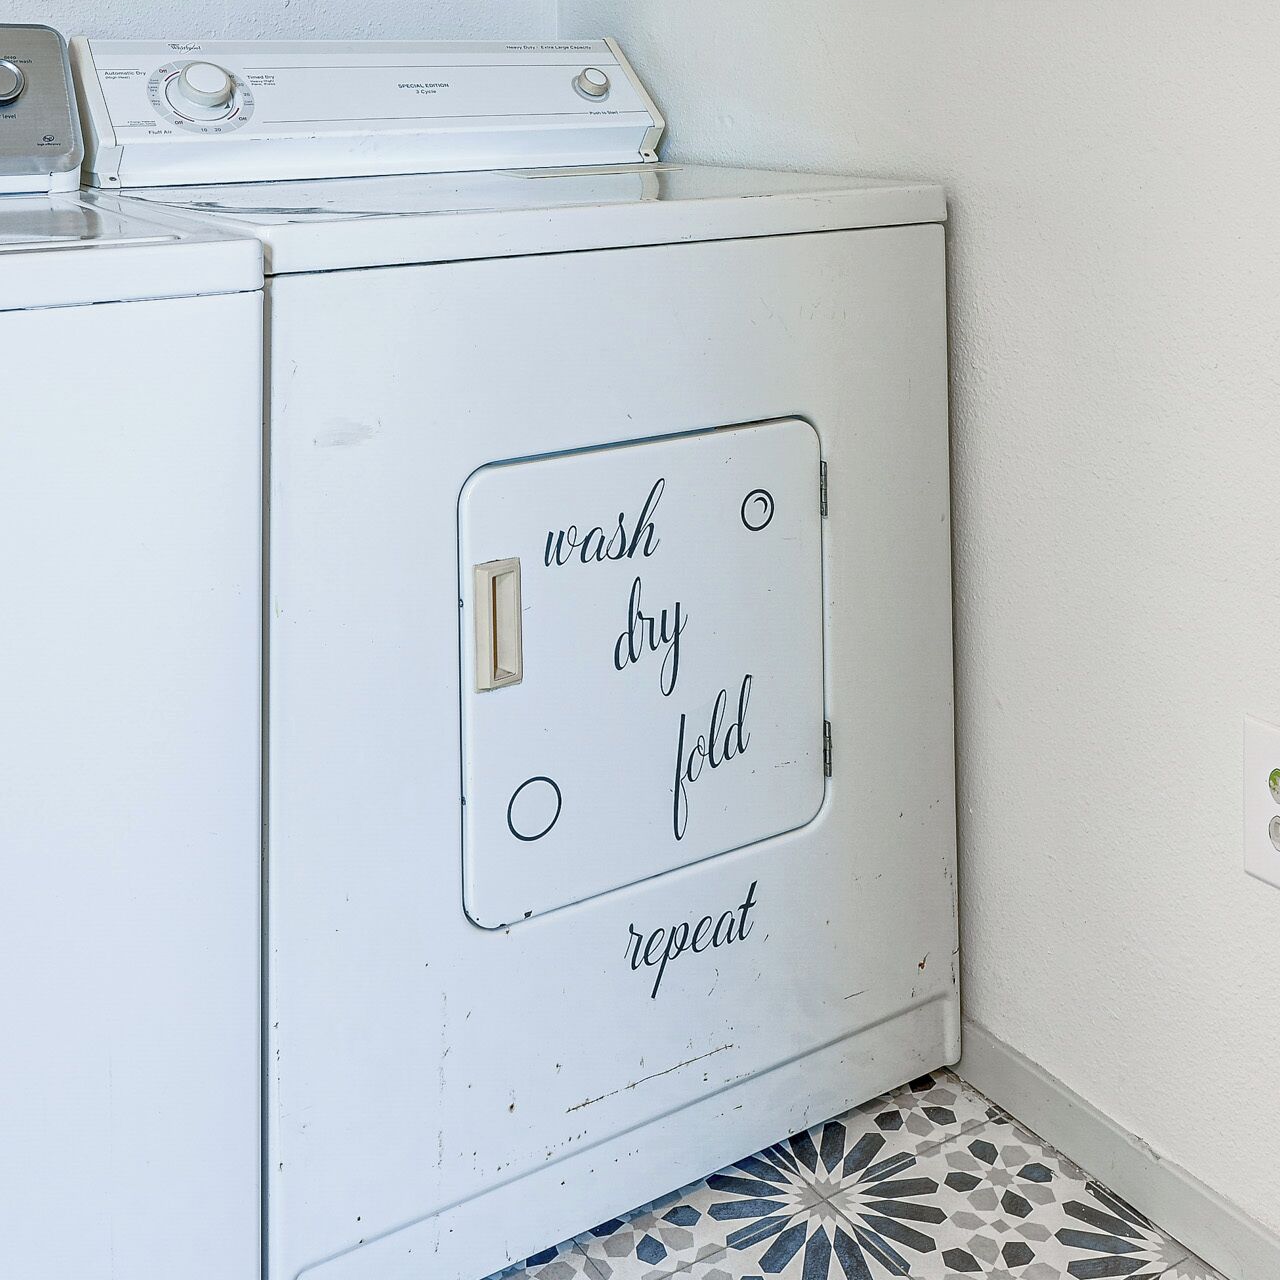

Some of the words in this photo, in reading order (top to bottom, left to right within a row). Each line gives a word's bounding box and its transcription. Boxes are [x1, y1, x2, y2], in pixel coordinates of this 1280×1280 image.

[544, 478, 665, 567] wash
[614, 576, 688, 697] dry
[673, 674, 753, 841] fold
[623, 880, 758, 999] repeat
